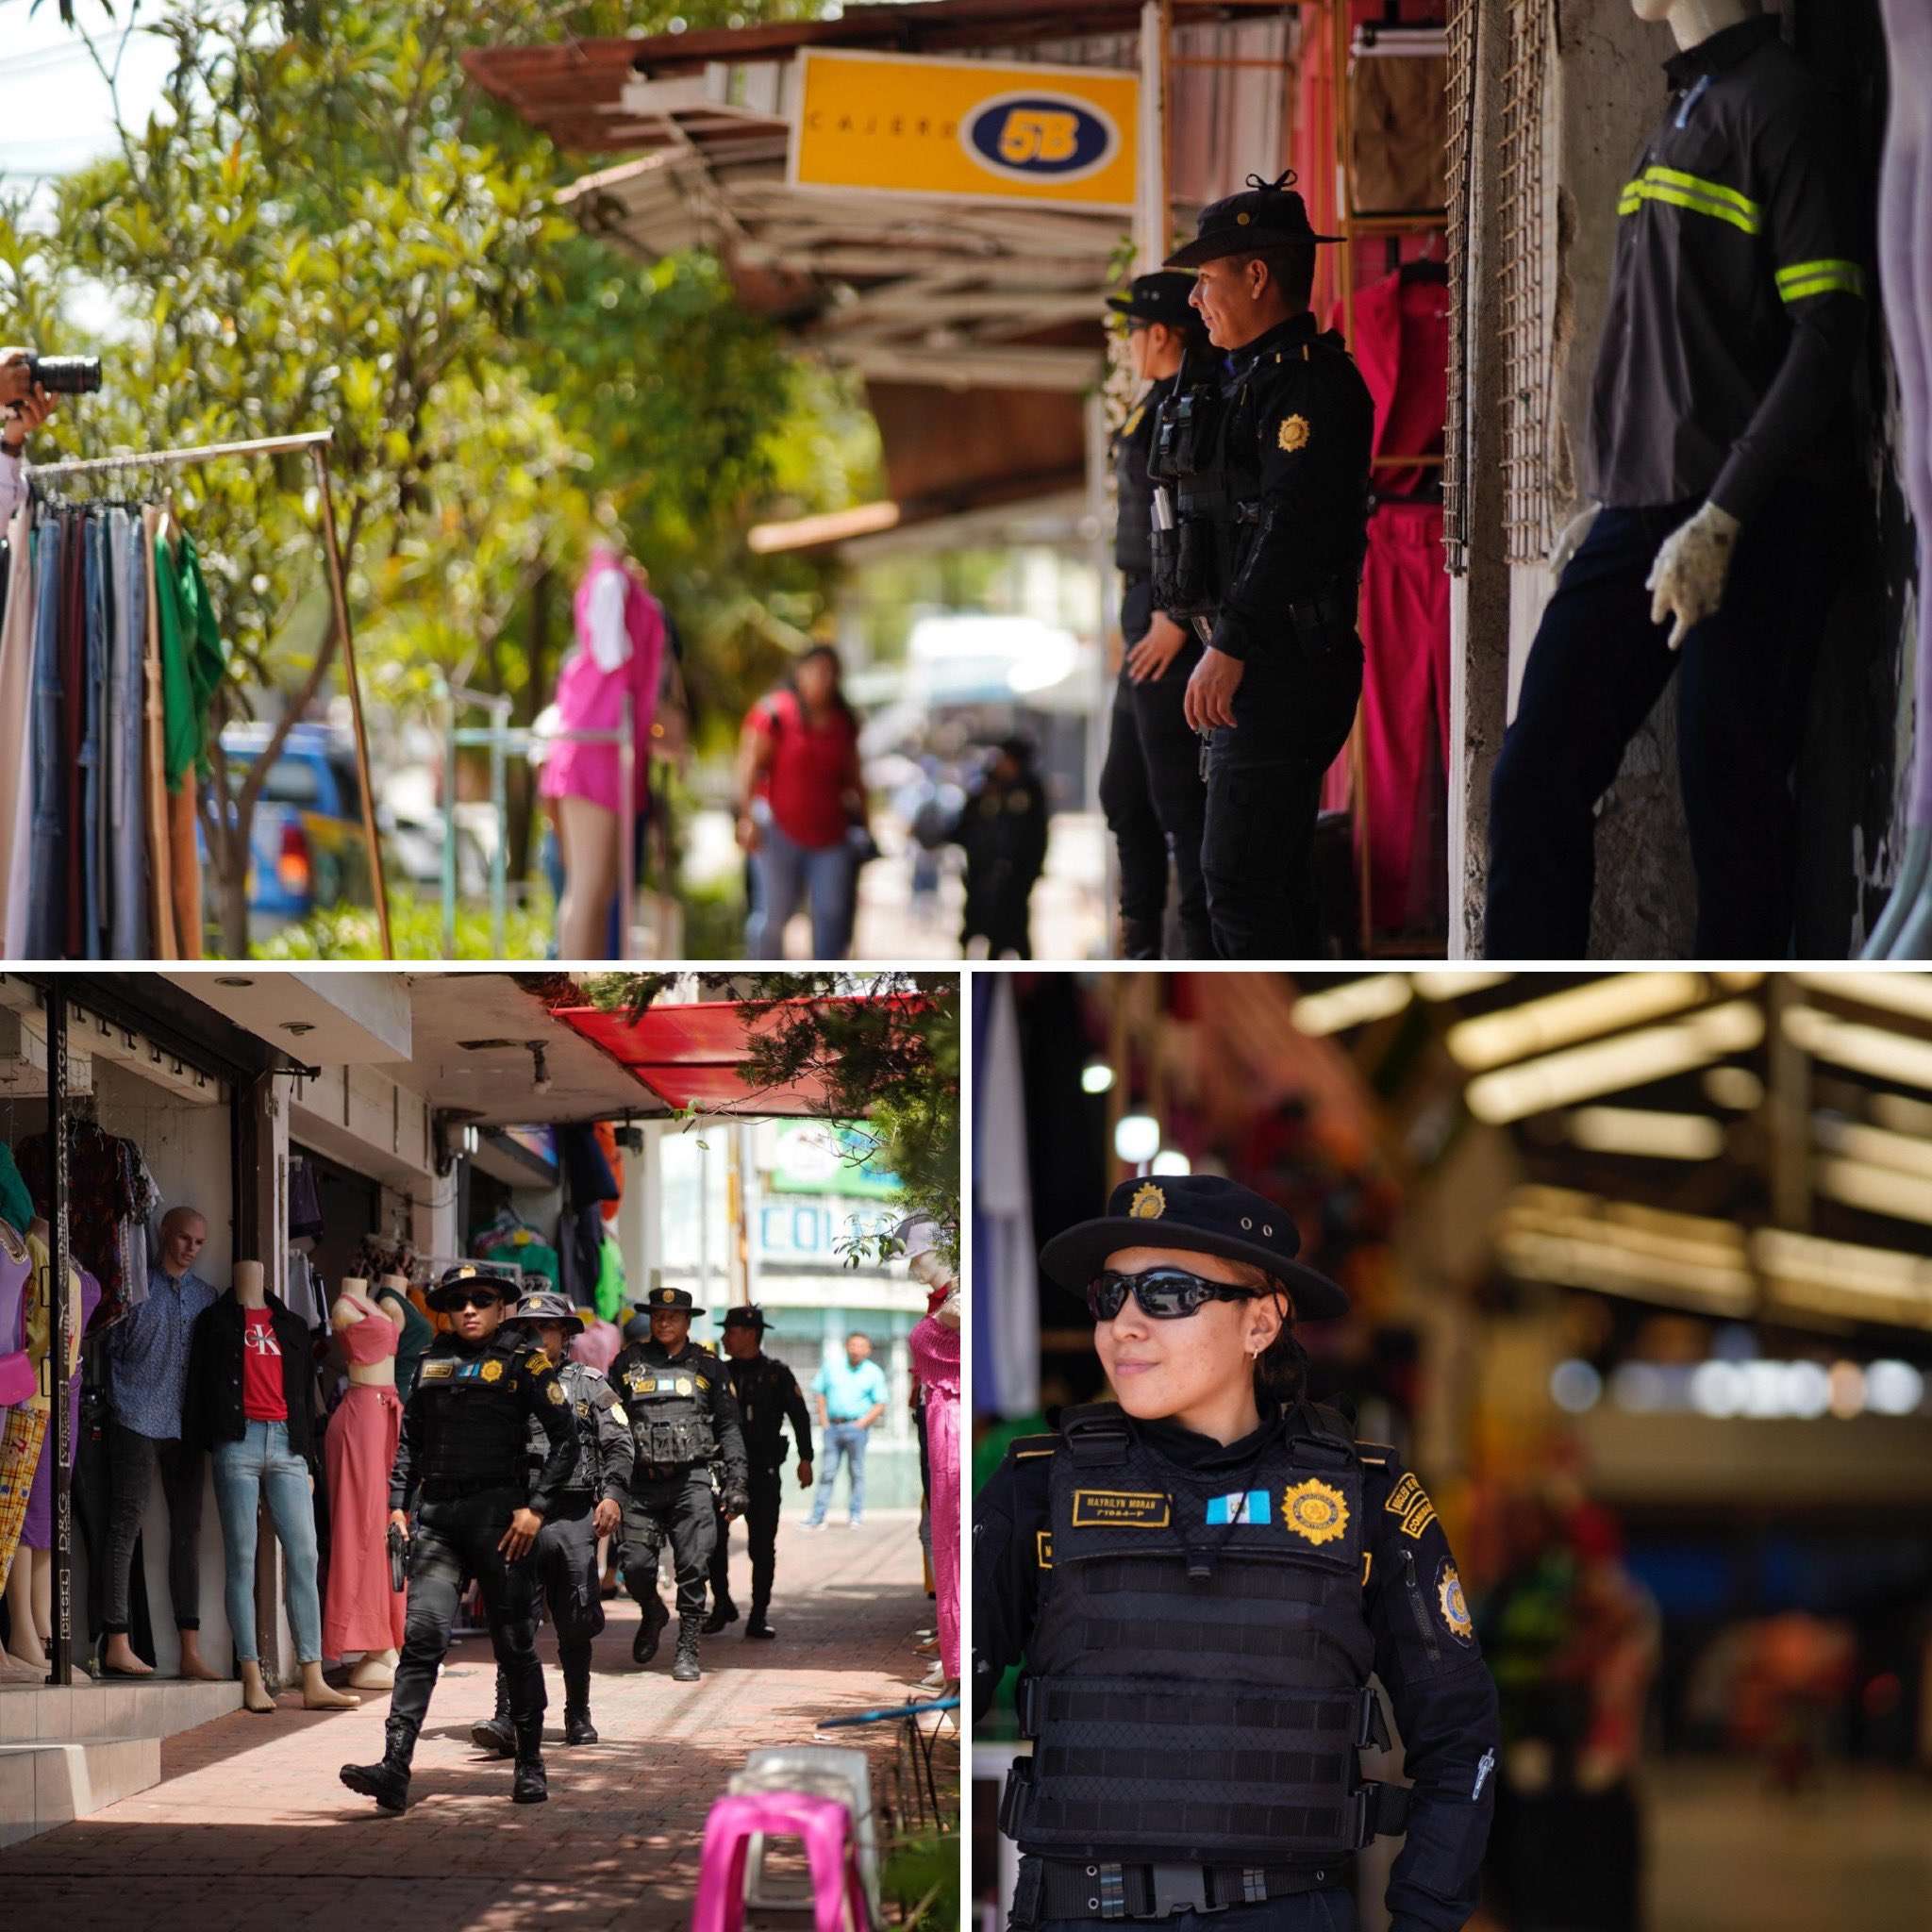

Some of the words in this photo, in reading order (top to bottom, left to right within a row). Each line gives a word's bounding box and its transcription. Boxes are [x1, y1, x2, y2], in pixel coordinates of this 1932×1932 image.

[998, 108, 1080, 164] 5B
[244, 1324, 282, 1356] CK
[58, 1492, 68, 1551] D&G
